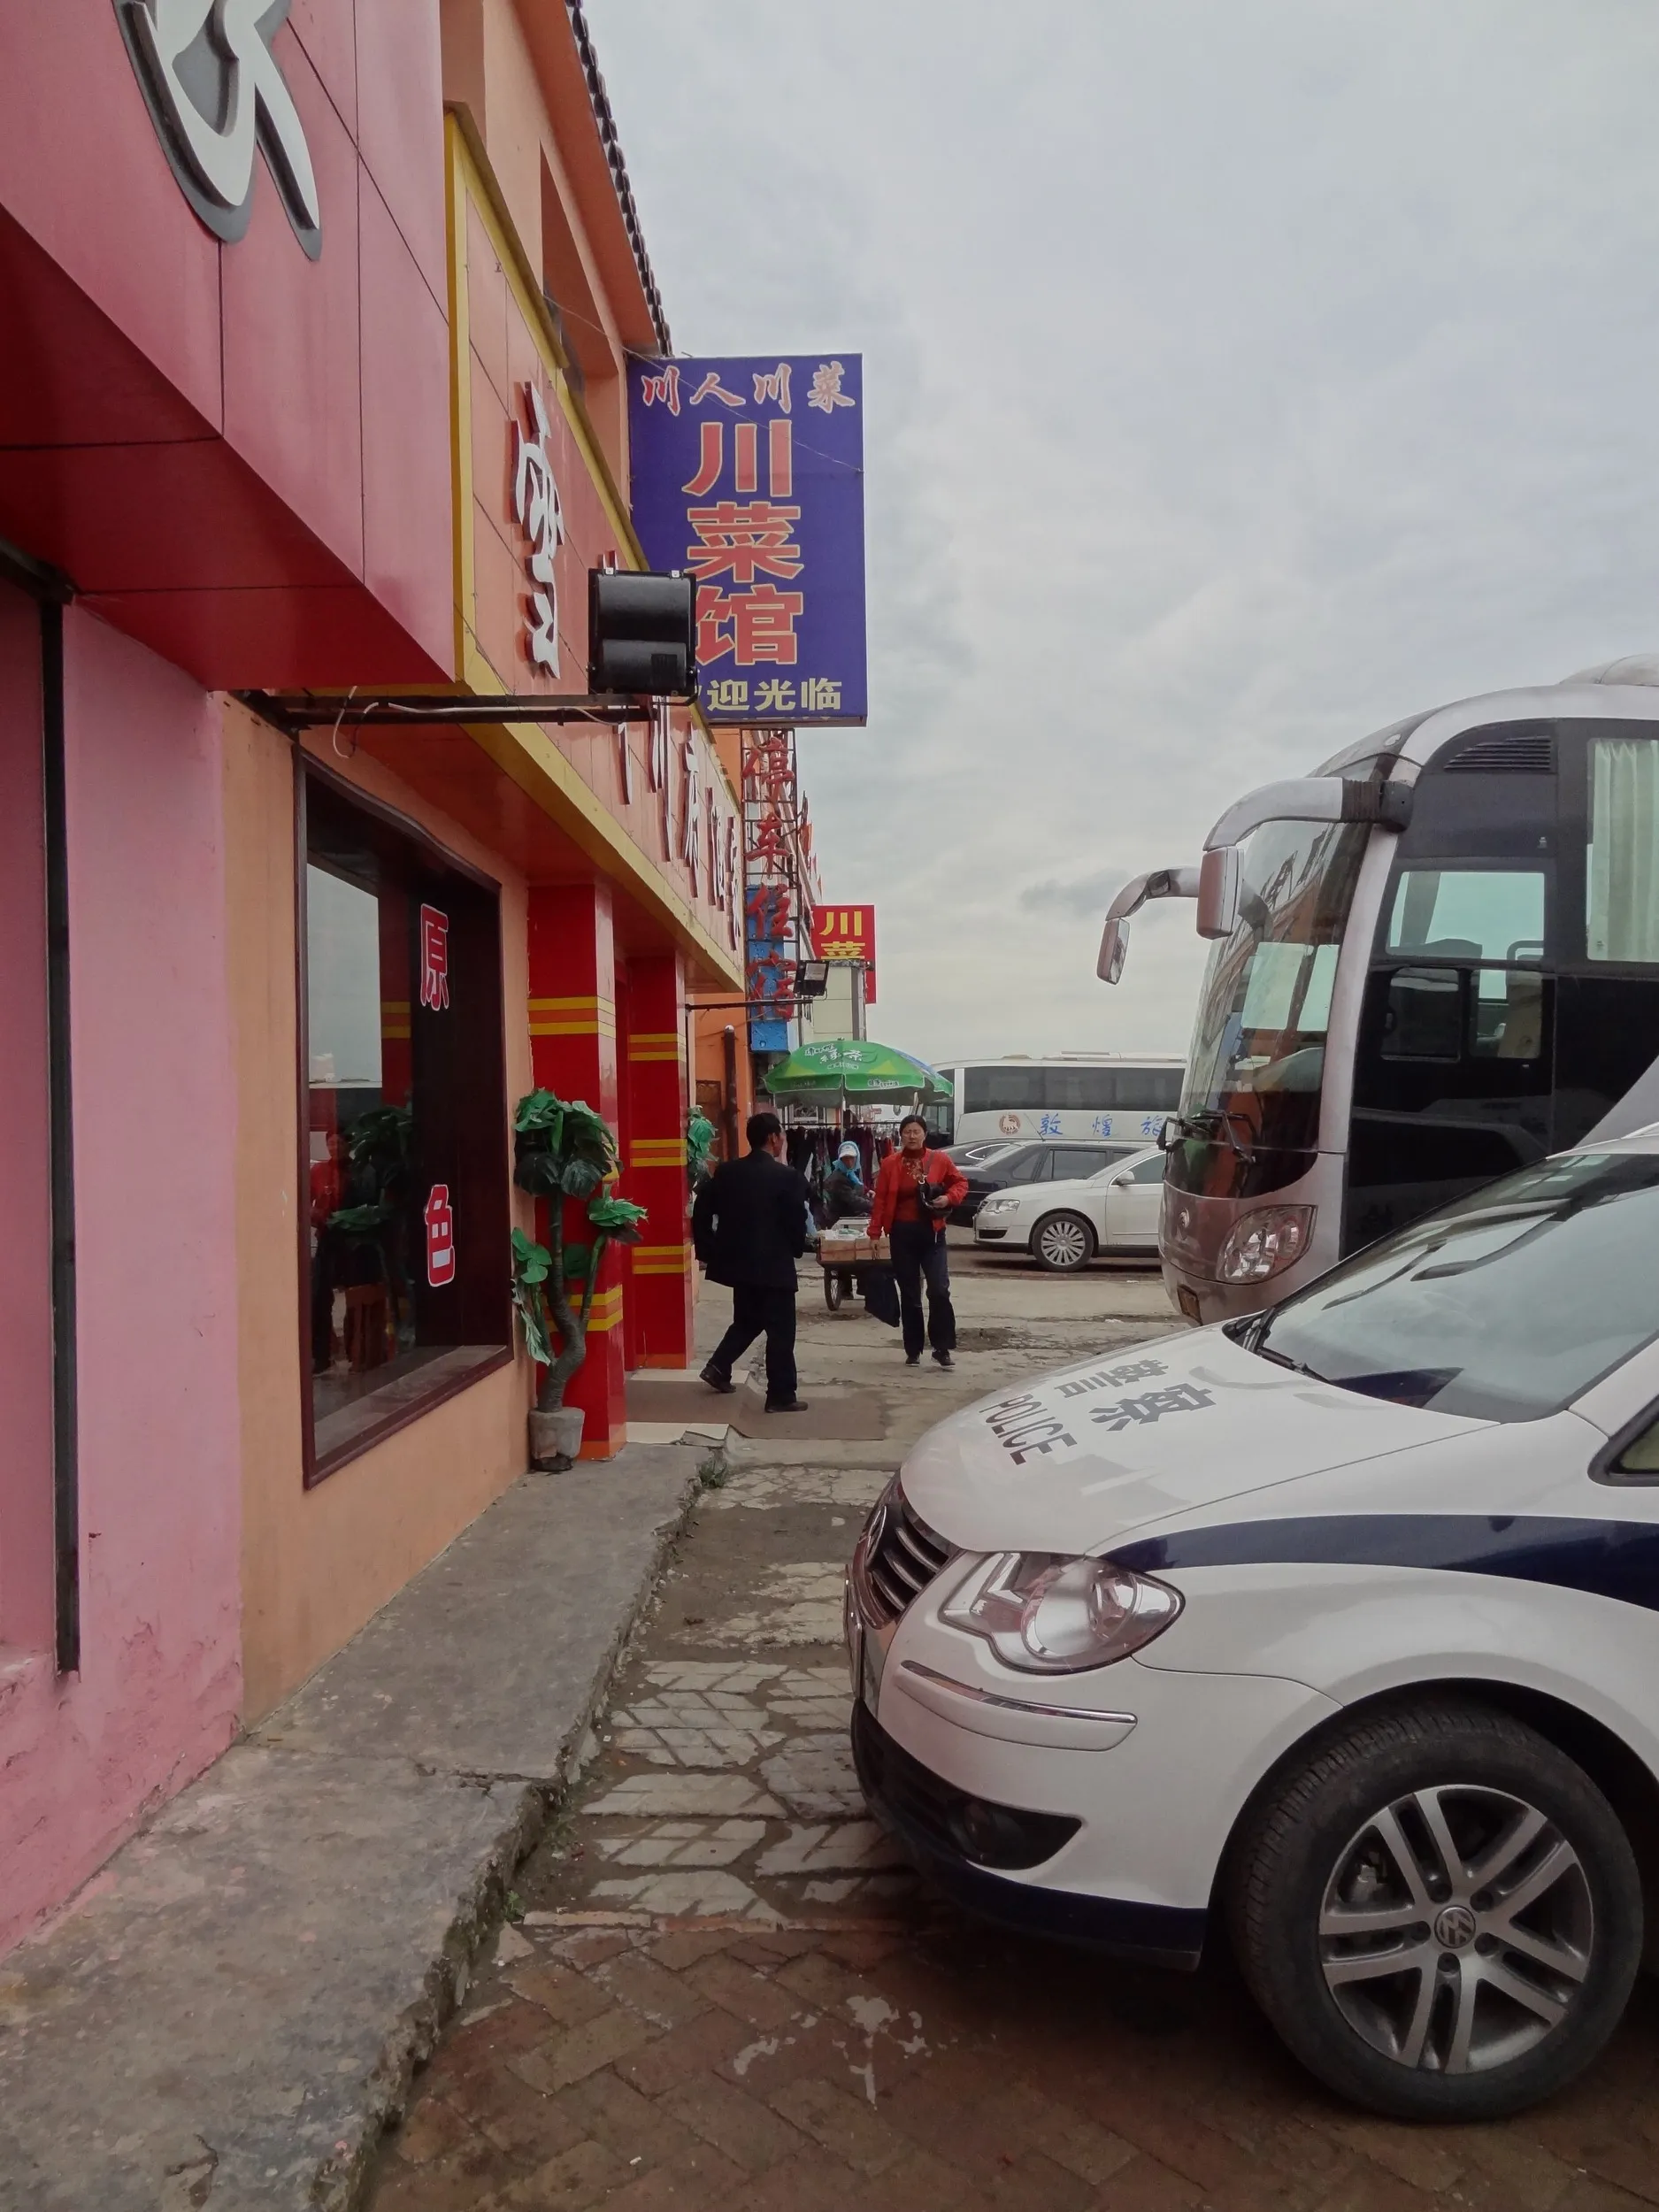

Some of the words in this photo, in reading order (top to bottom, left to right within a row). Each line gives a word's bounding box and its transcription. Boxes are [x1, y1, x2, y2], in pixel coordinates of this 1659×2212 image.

[641, 361, 856, 416] 川人川菜
[681, 419, 804, 666] 川菜馆
[695, 678, 842, 711] 迎光临
[979, 1394, 1078, 1465] POLICE
[1055, 1359, 1217, 1431] 警察
